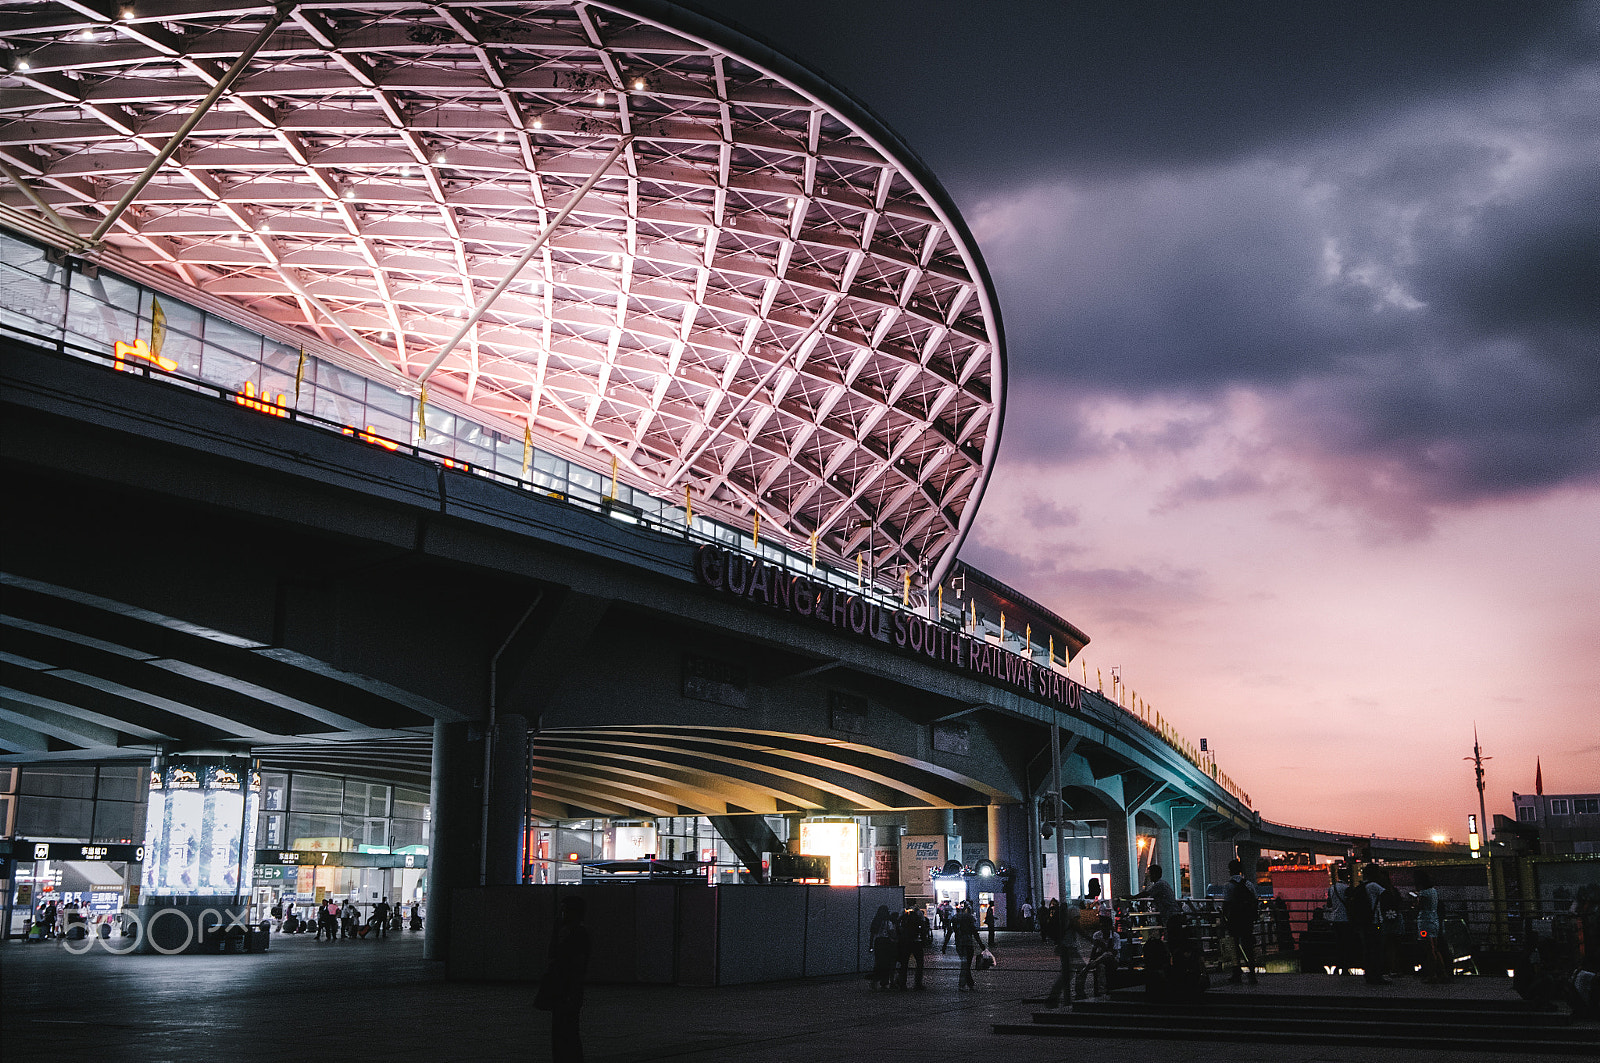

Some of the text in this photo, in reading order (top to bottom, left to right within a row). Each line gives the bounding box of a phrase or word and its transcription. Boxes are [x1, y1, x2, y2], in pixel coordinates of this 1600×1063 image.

[698, 544, 1082, 711] GUANGZHOU SOUTH RAILWAY STATION
[136, 847, 145, 862] 9
[321, 853, 329, 866] 7
